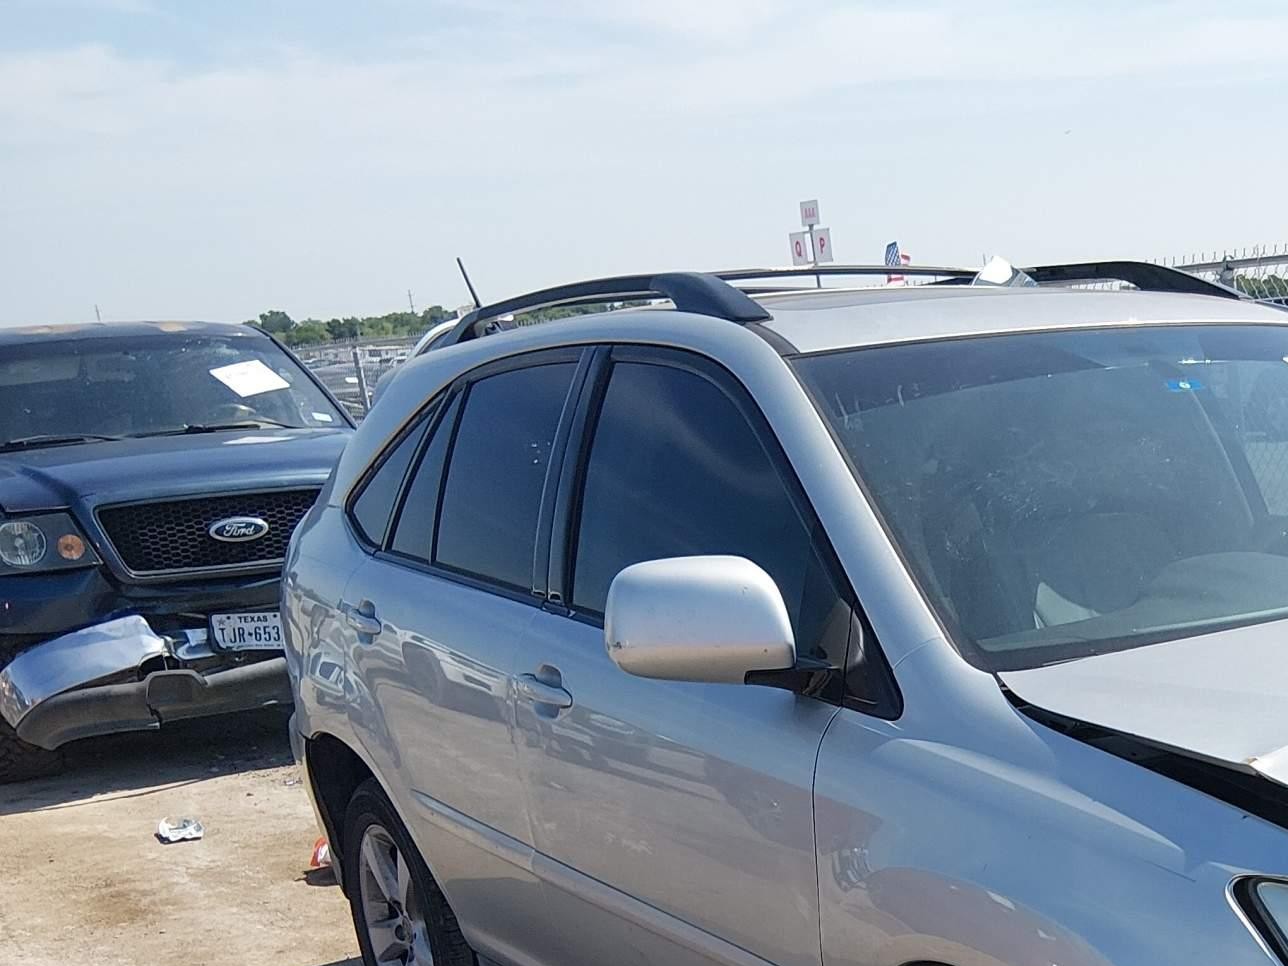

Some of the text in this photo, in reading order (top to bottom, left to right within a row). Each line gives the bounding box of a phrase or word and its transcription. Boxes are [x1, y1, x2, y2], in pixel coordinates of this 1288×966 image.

[795, 240, 802, 257] Q
[819, 237, 825, 254] P
[223, 523, 255, 537] Ford
[237, 615, 269, 624] TEXAS
